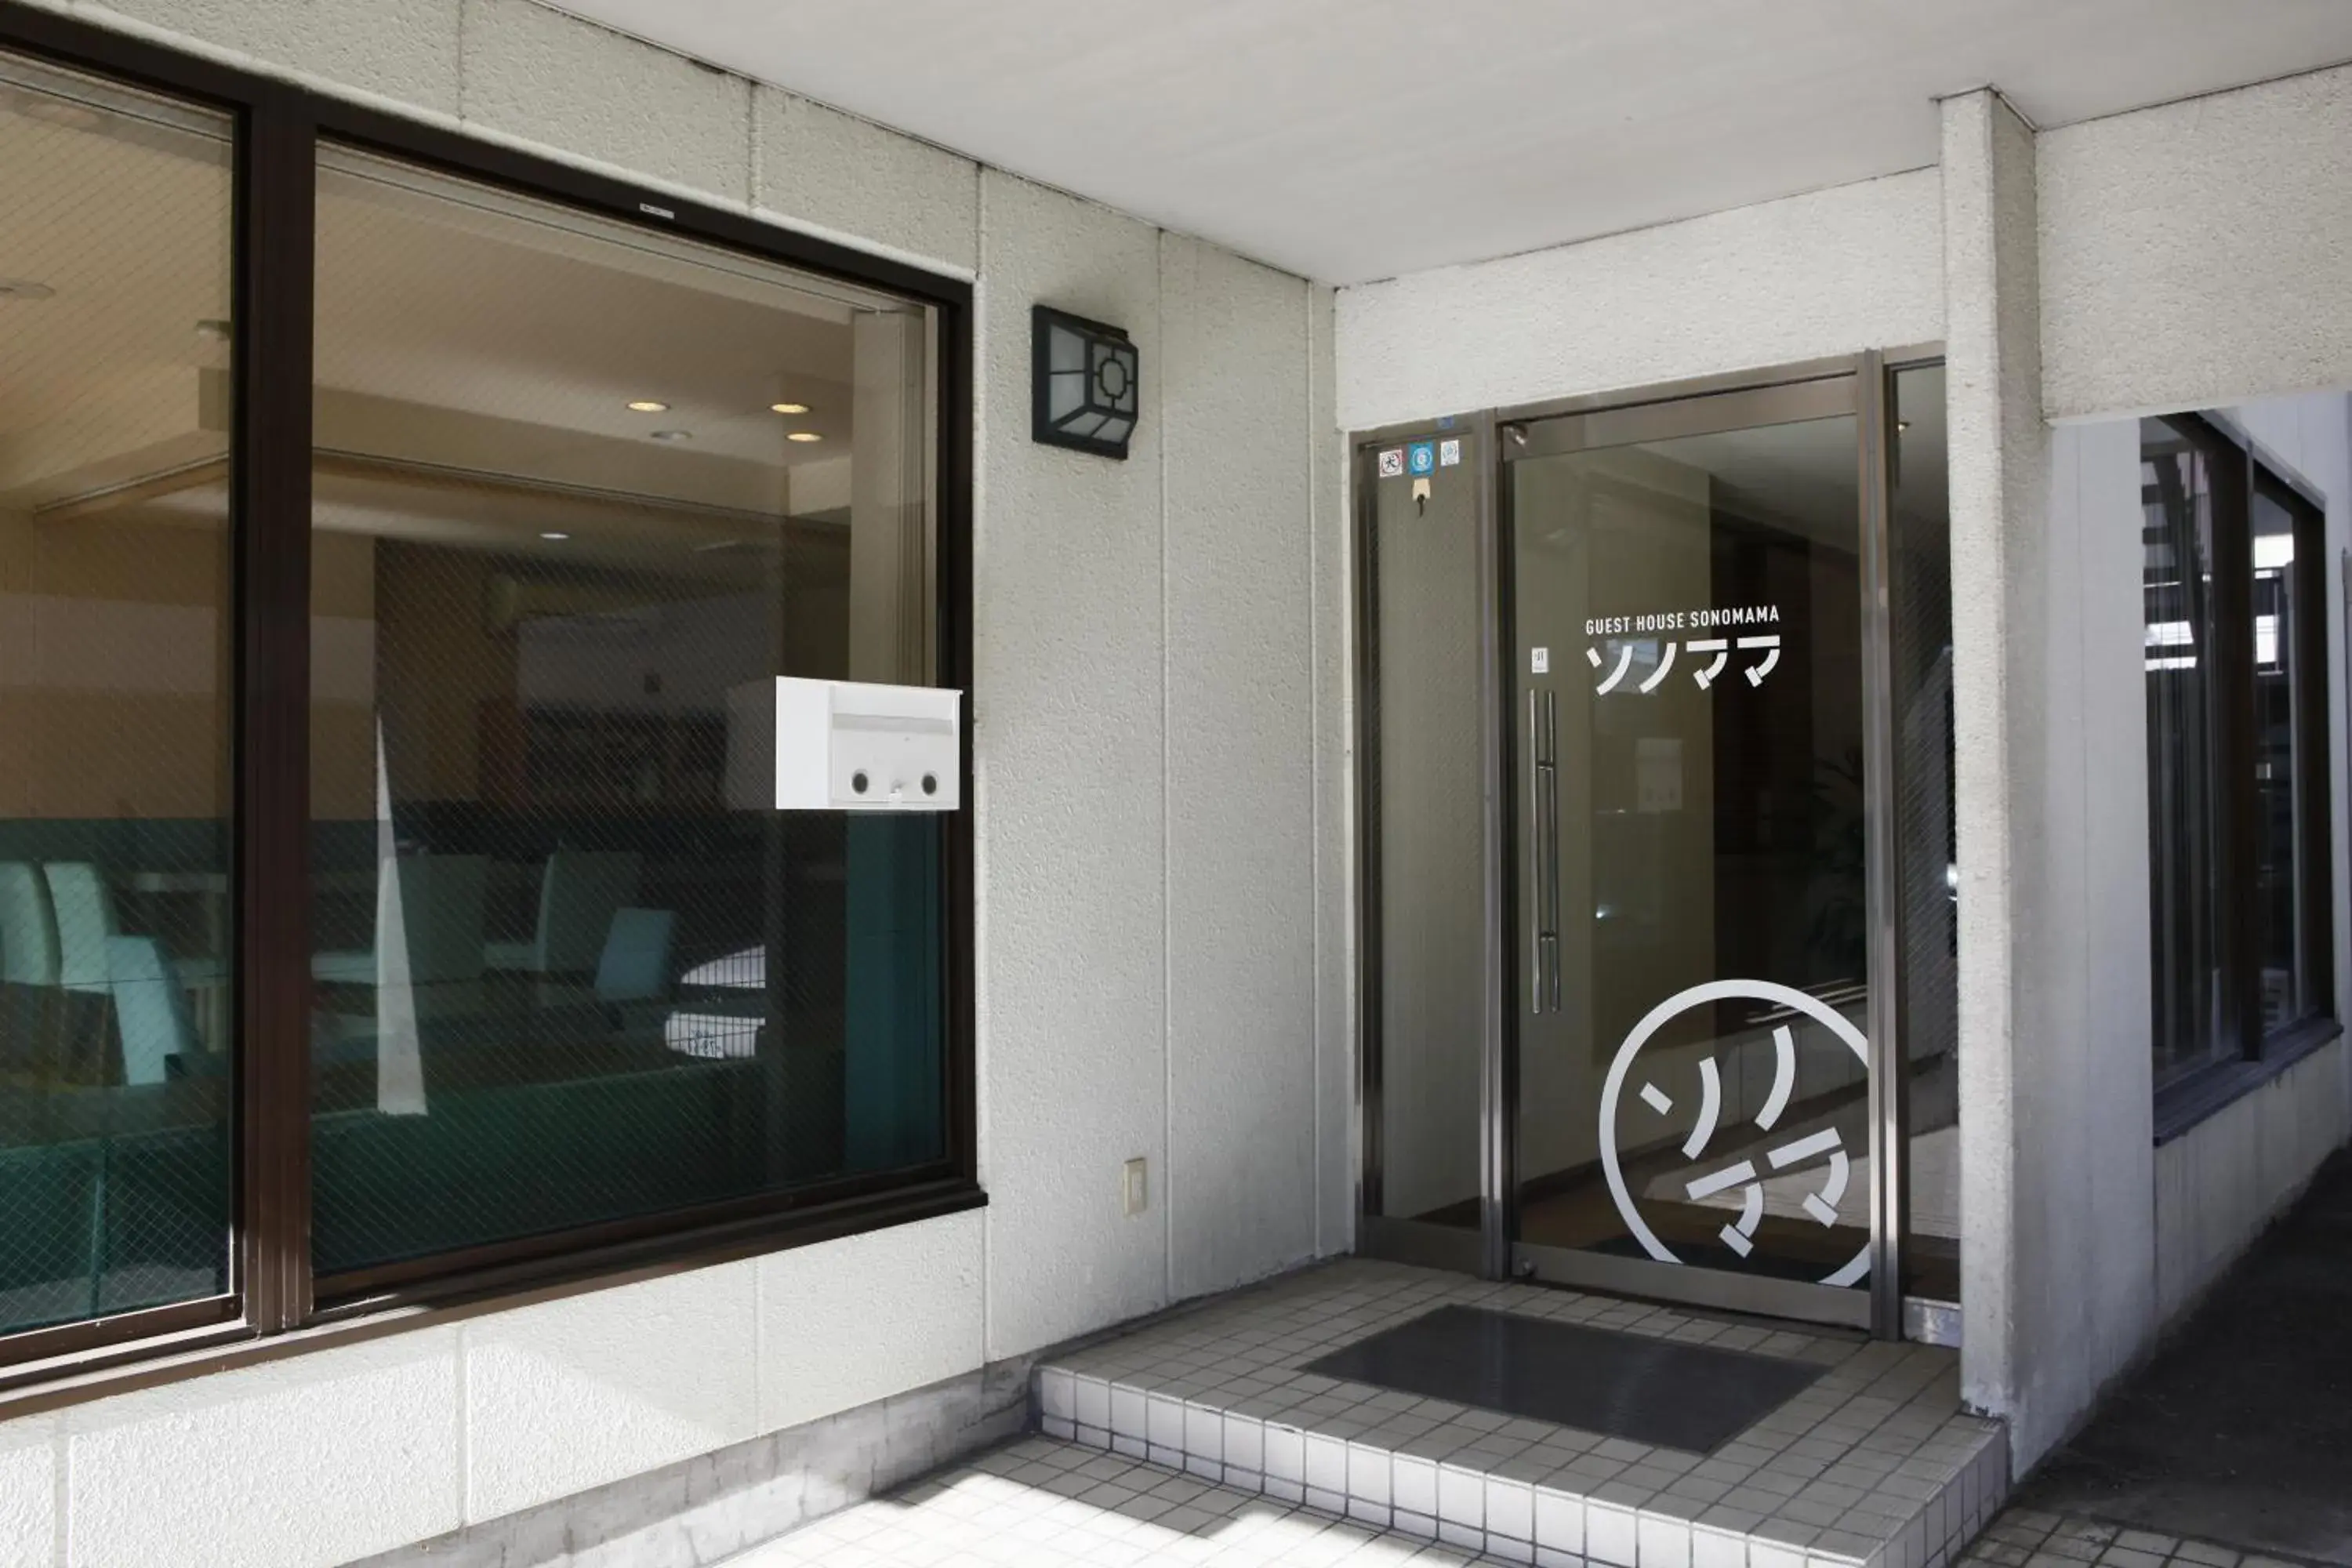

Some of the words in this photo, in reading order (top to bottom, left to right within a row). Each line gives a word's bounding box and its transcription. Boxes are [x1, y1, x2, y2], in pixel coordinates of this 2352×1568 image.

[1586, 616, 1630, 635] GUEST
[1636, 612, 1684, 631] HOUSE
[1690, 605, 1780, 627] SONOMAMA
[1586, 635, 1780, 696] ソノママ
